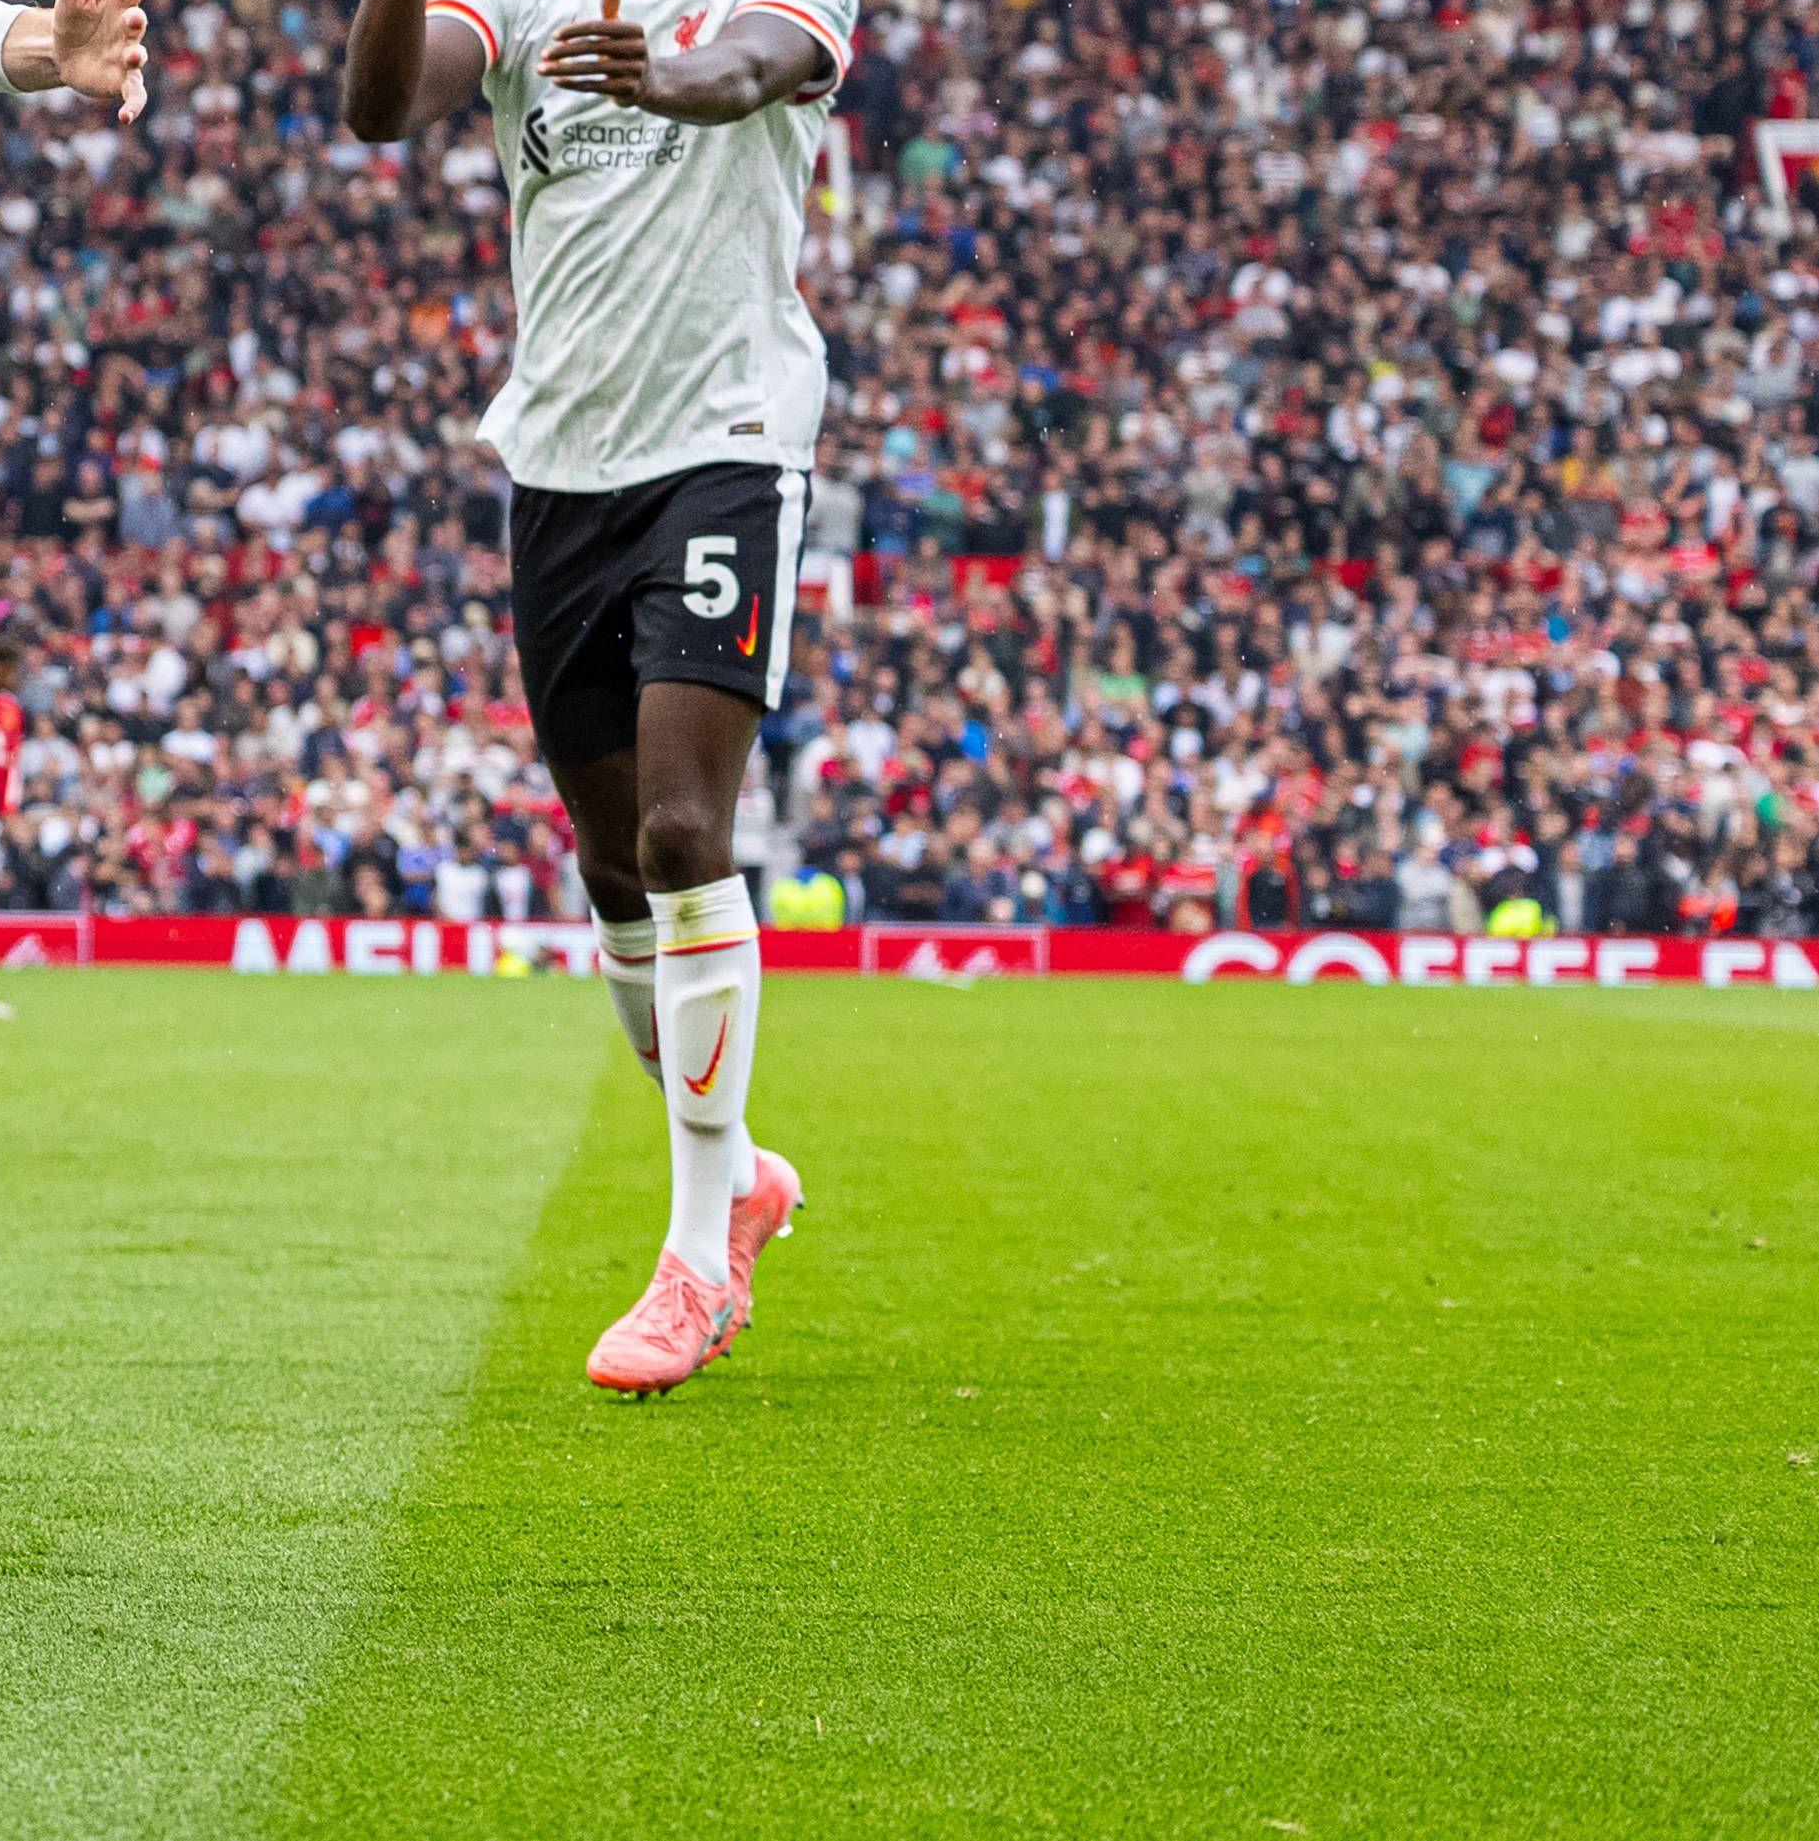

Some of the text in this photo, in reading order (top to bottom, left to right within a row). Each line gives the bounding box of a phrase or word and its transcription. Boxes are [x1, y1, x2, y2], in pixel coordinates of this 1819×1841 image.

[563, 123, 679, 145] standard
[563, 144, 684, 168] chartered
[683, 535, 740, 619] 5
